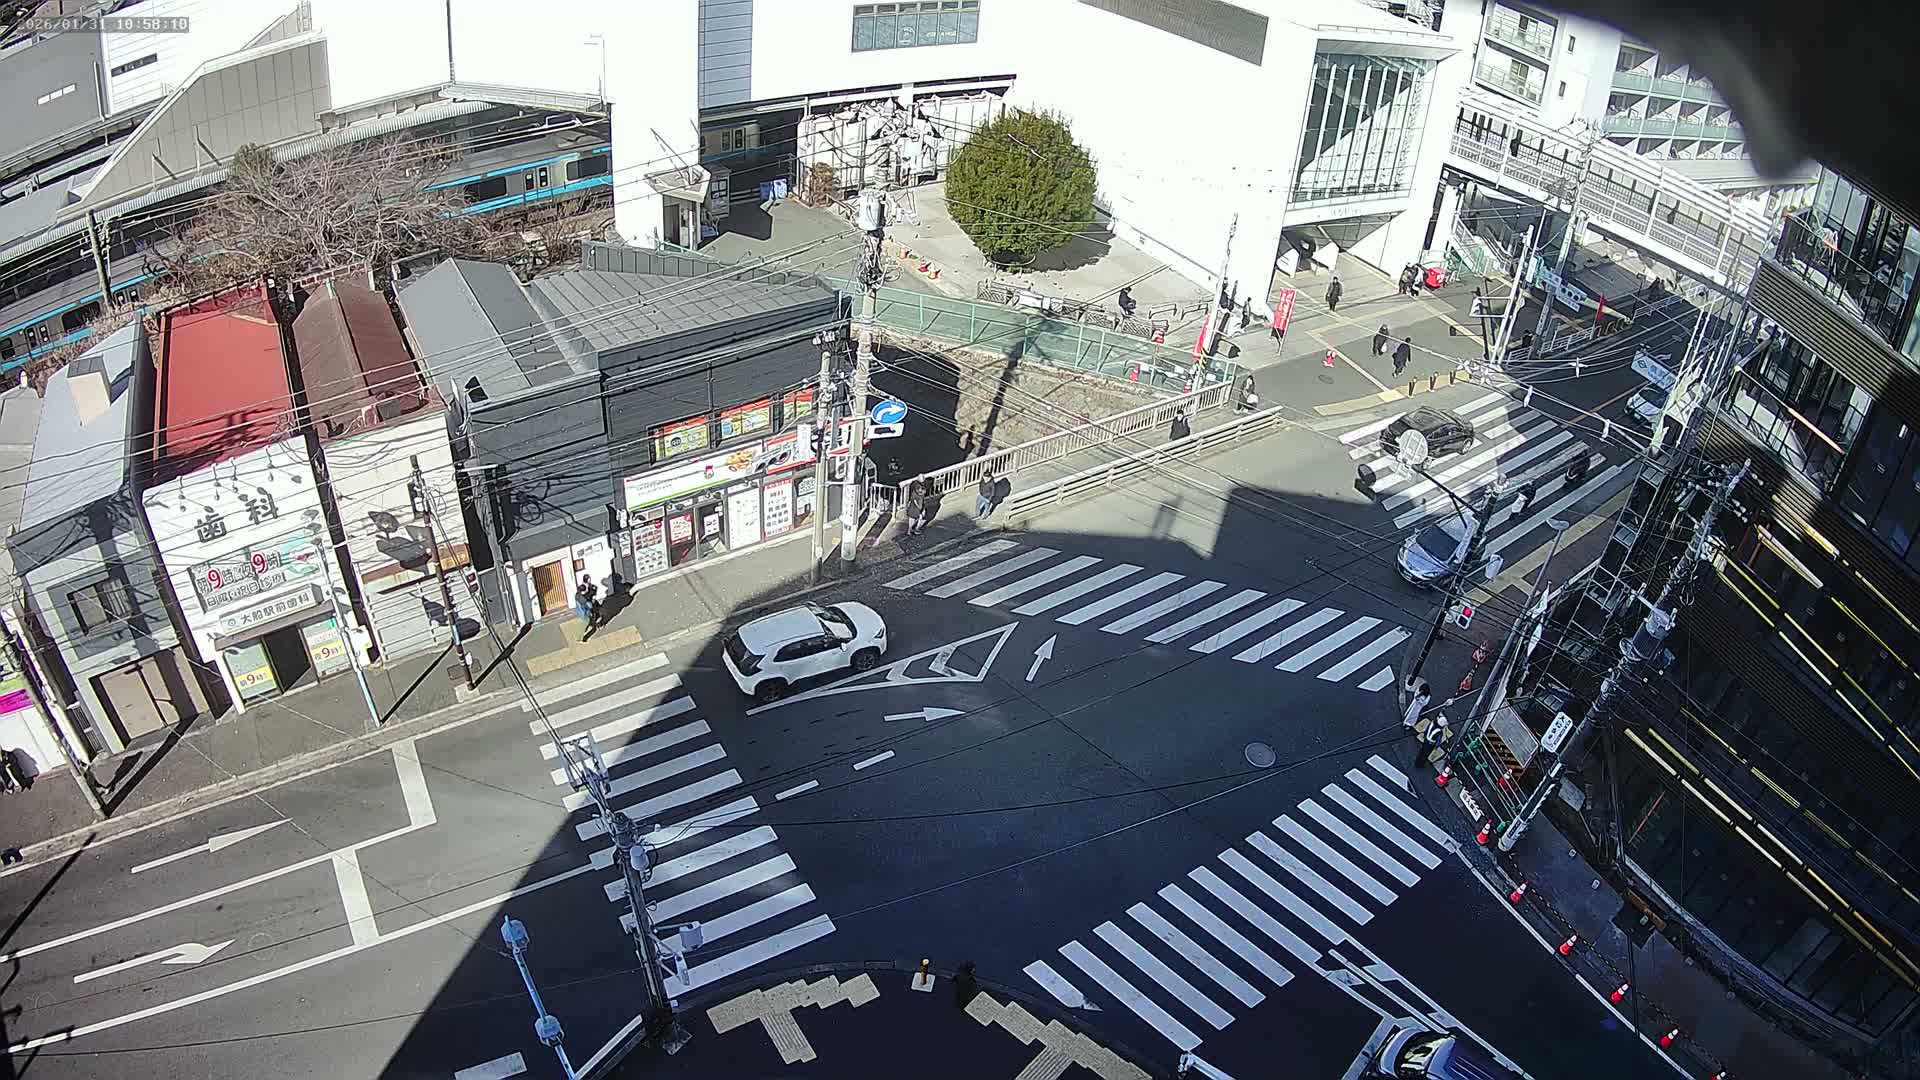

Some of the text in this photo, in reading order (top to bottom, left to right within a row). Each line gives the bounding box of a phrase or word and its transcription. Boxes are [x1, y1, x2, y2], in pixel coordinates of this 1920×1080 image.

[193, 493, 279, 543] 歯科
[240, 591, 310, 625] 大船駅前歯科
